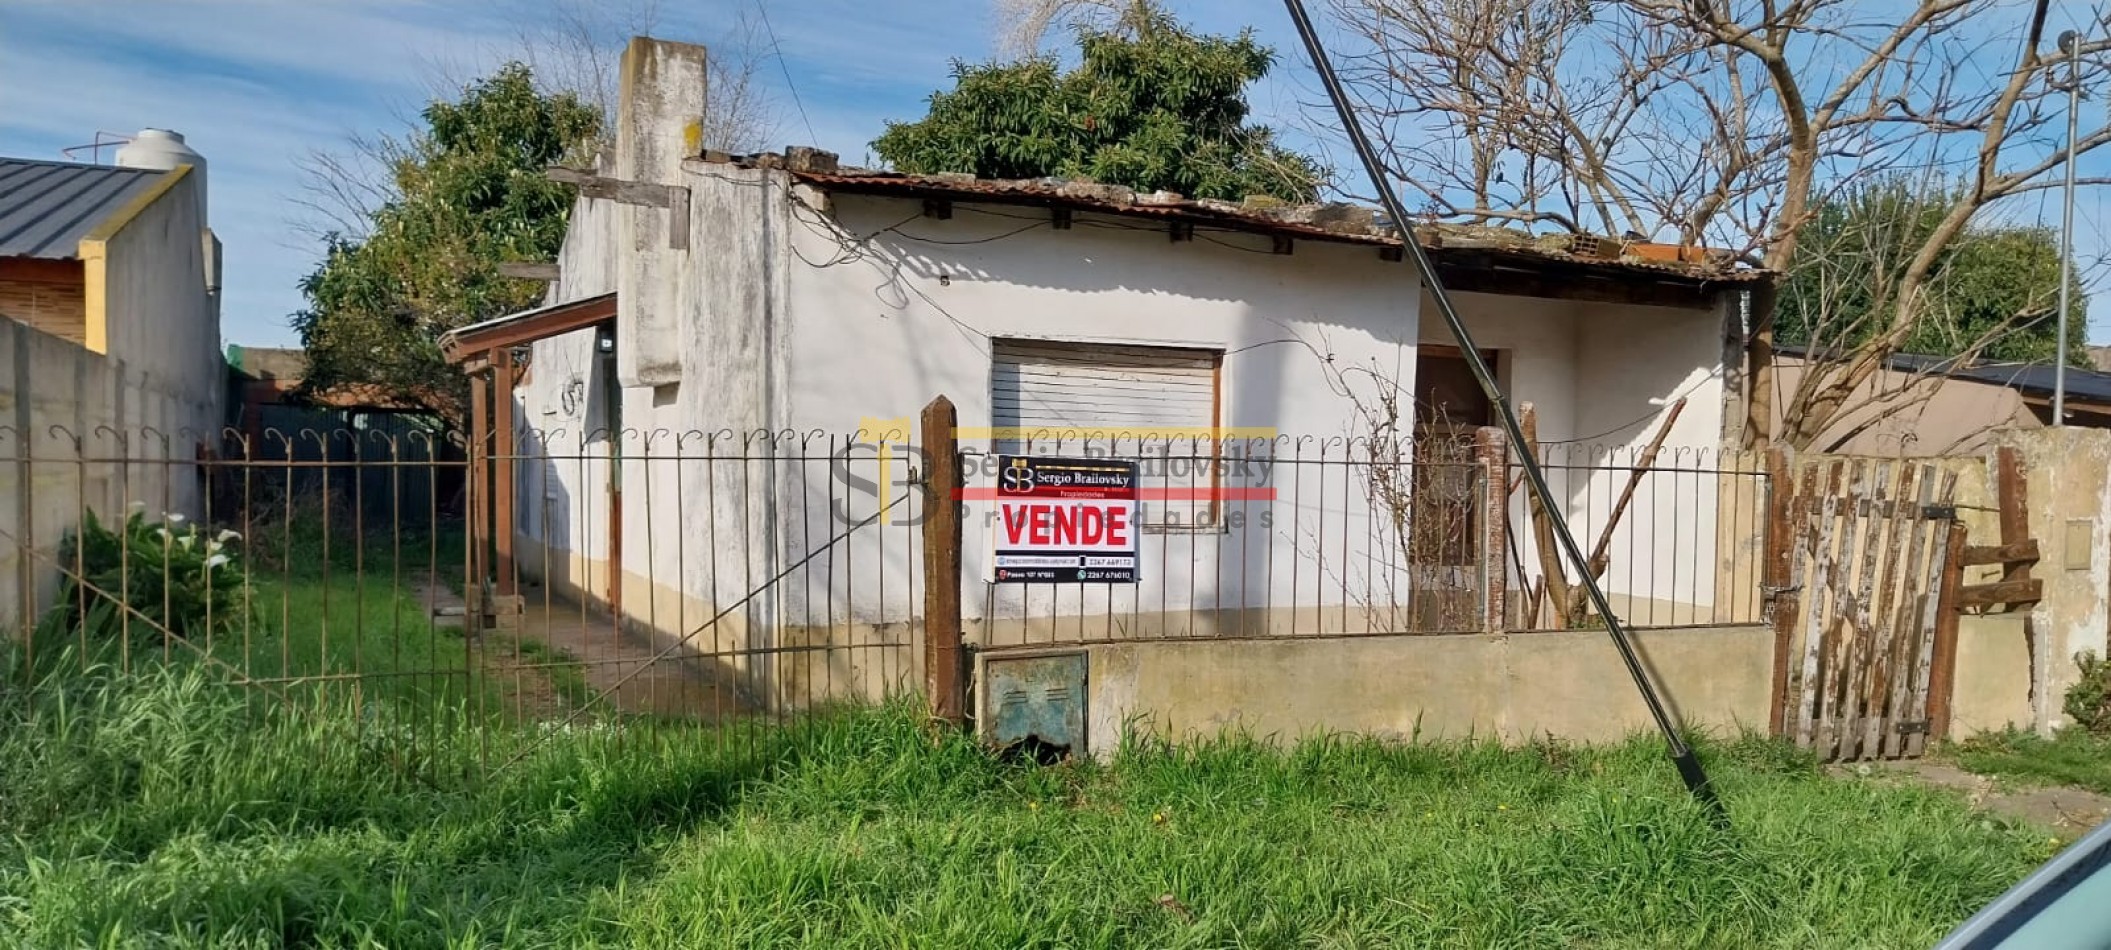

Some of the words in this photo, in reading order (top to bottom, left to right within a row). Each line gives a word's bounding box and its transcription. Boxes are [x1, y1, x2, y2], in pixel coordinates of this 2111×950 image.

[1003, 466, 1034, 493] SB
[1036, 471, 1071, 486] Sergio
[1074, 472, 1130, 488] Brailovsky
[1002, 503, 1126, 546] VENDE
